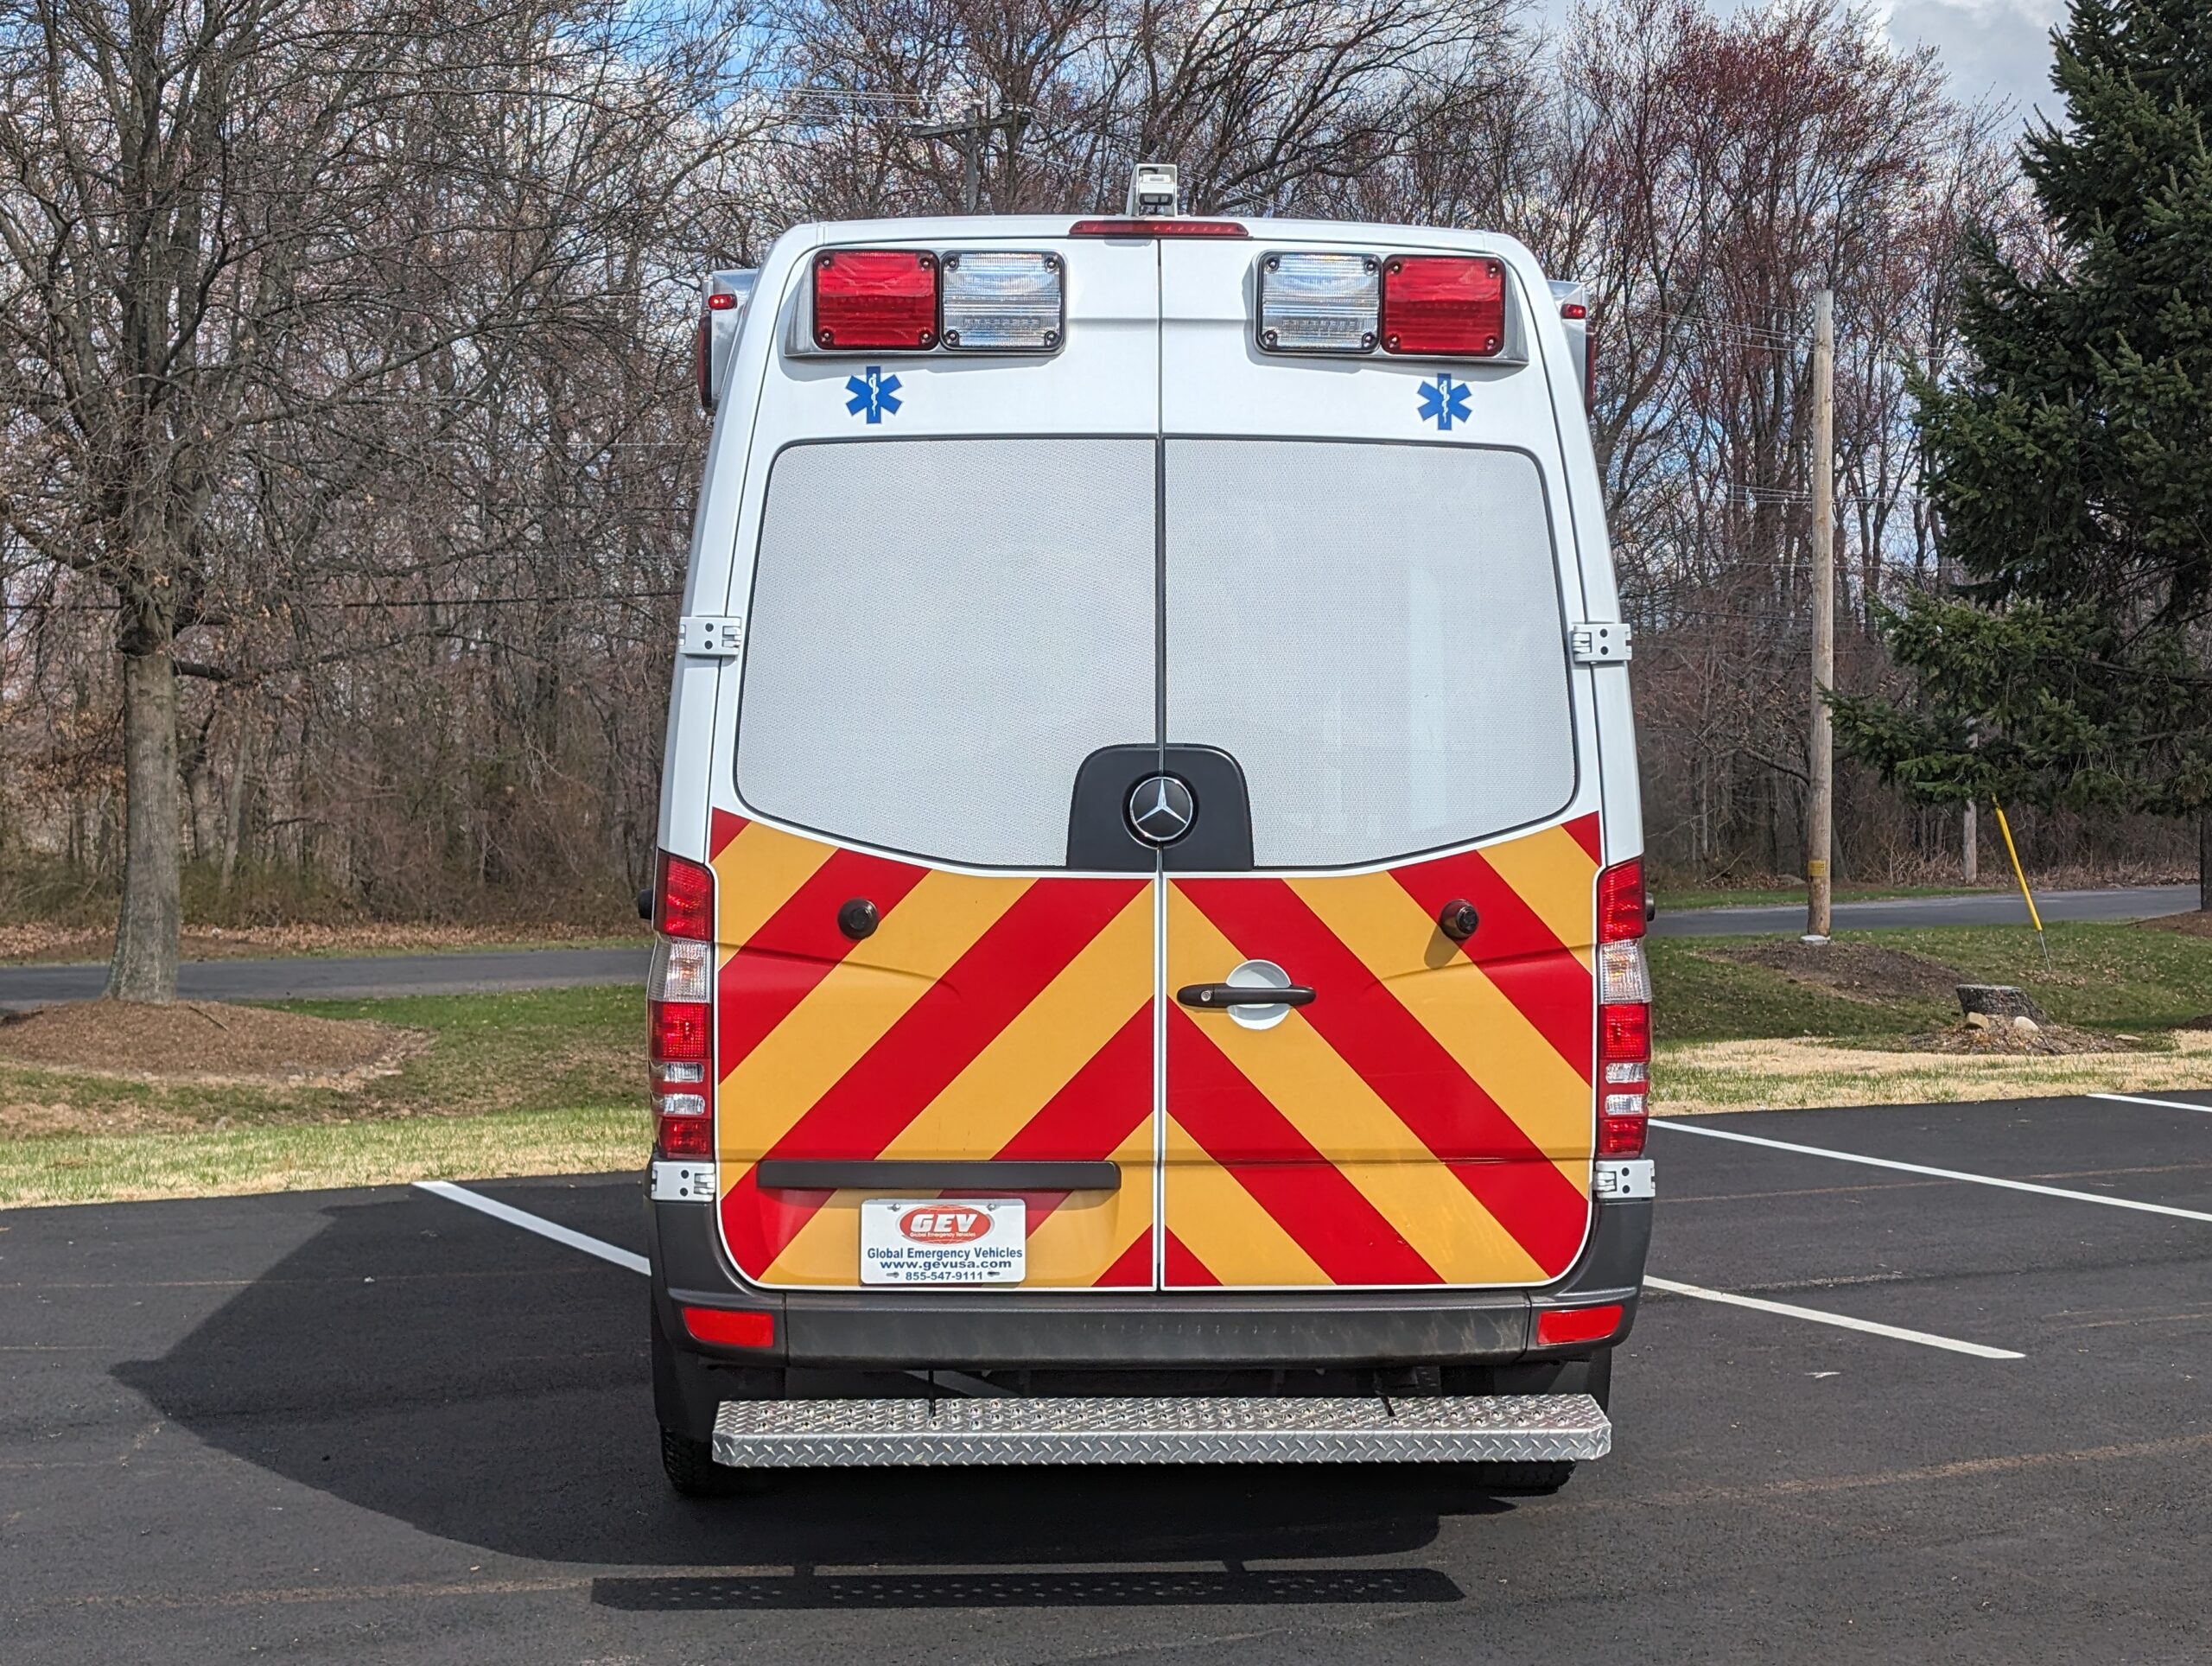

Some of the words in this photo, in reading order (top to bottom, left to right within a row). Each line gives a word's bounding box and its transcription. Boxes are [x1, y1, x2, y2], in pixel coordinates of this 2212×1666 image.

[910, 1214, 977, 1232] GEV
[867, 1247, 903, 1259] Global
[907, 1247, 970, 1262] Emergency
[974, 1247, 1023, 1258] Vehicles
[880, 1261, 1012, 1271] www.gevusa.com
[906, 1271, 982, 1281] 855-547-9111
